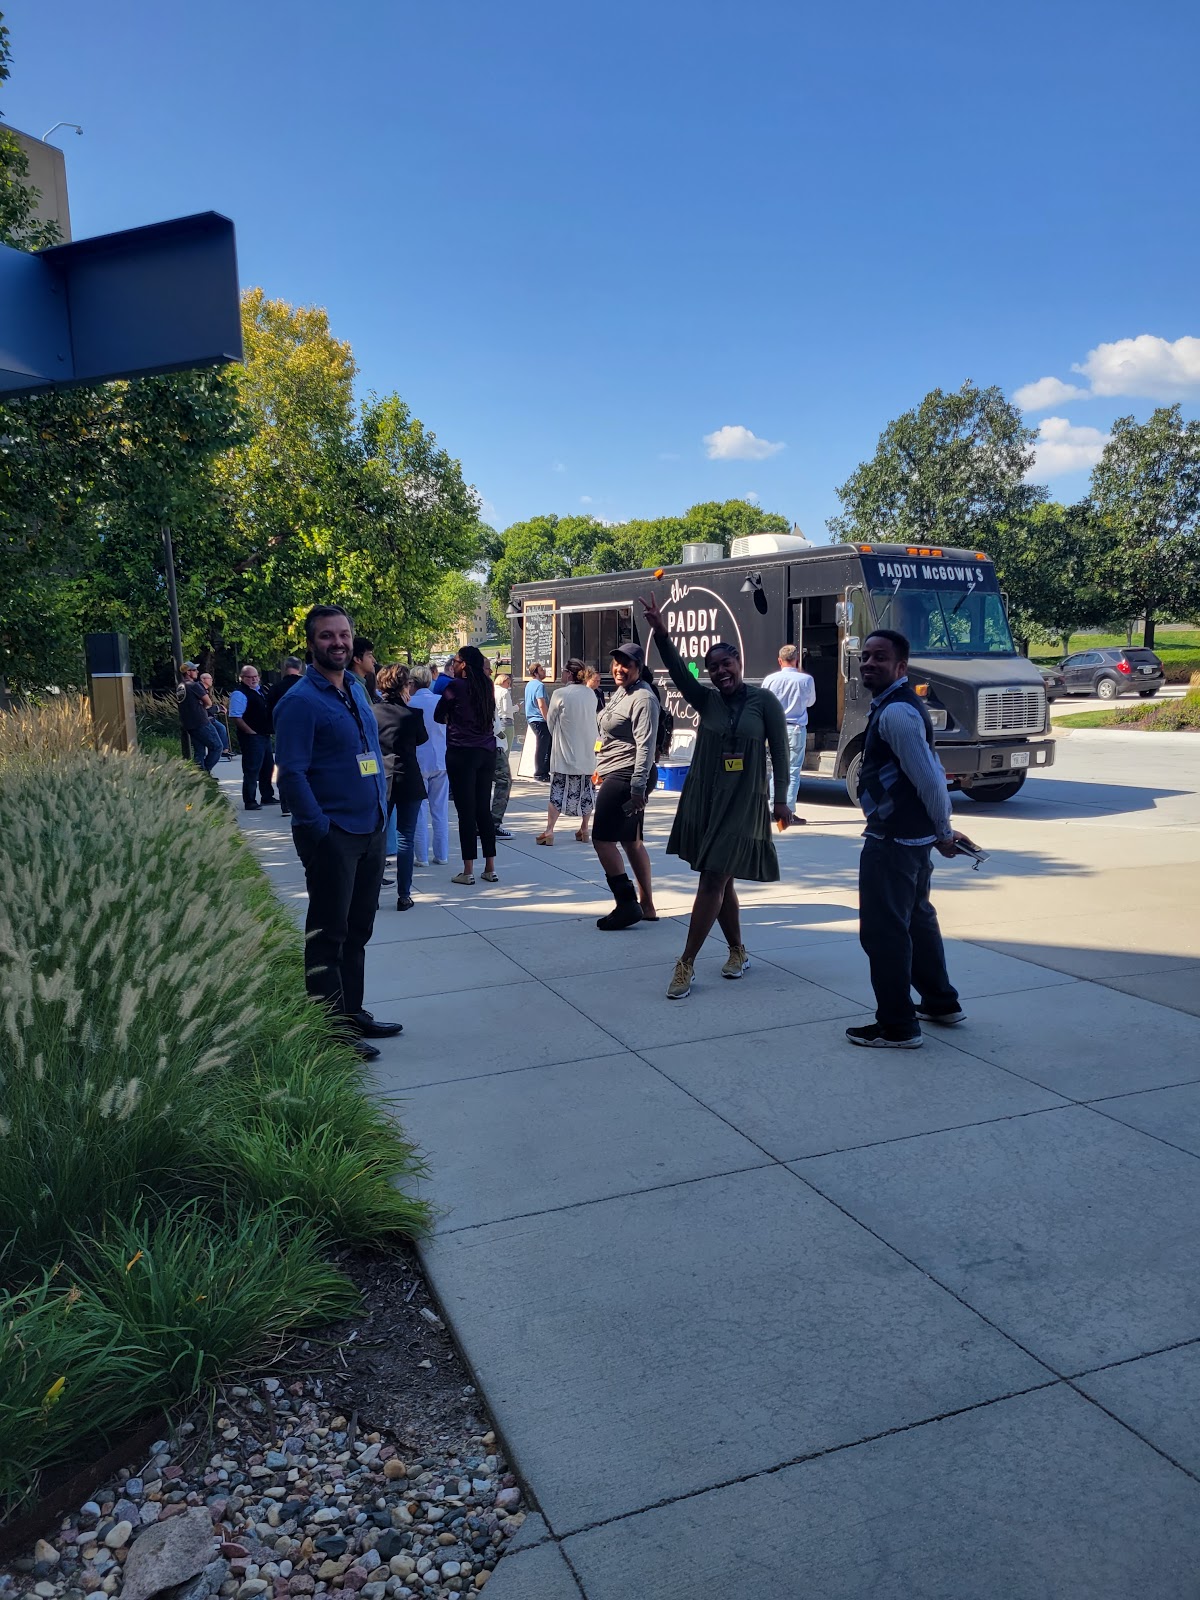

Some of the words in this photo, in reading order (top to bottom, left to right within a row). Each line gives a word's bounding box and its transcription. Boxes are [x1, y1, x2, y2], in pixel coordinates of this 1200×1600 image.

[878, 562, 918, 579] PADDY
[671, 579, 689, 603] the
[667, 608, 718, 632] PADDY
[361, 762, 368, 771] V
[727, 760, 734, 769] V
